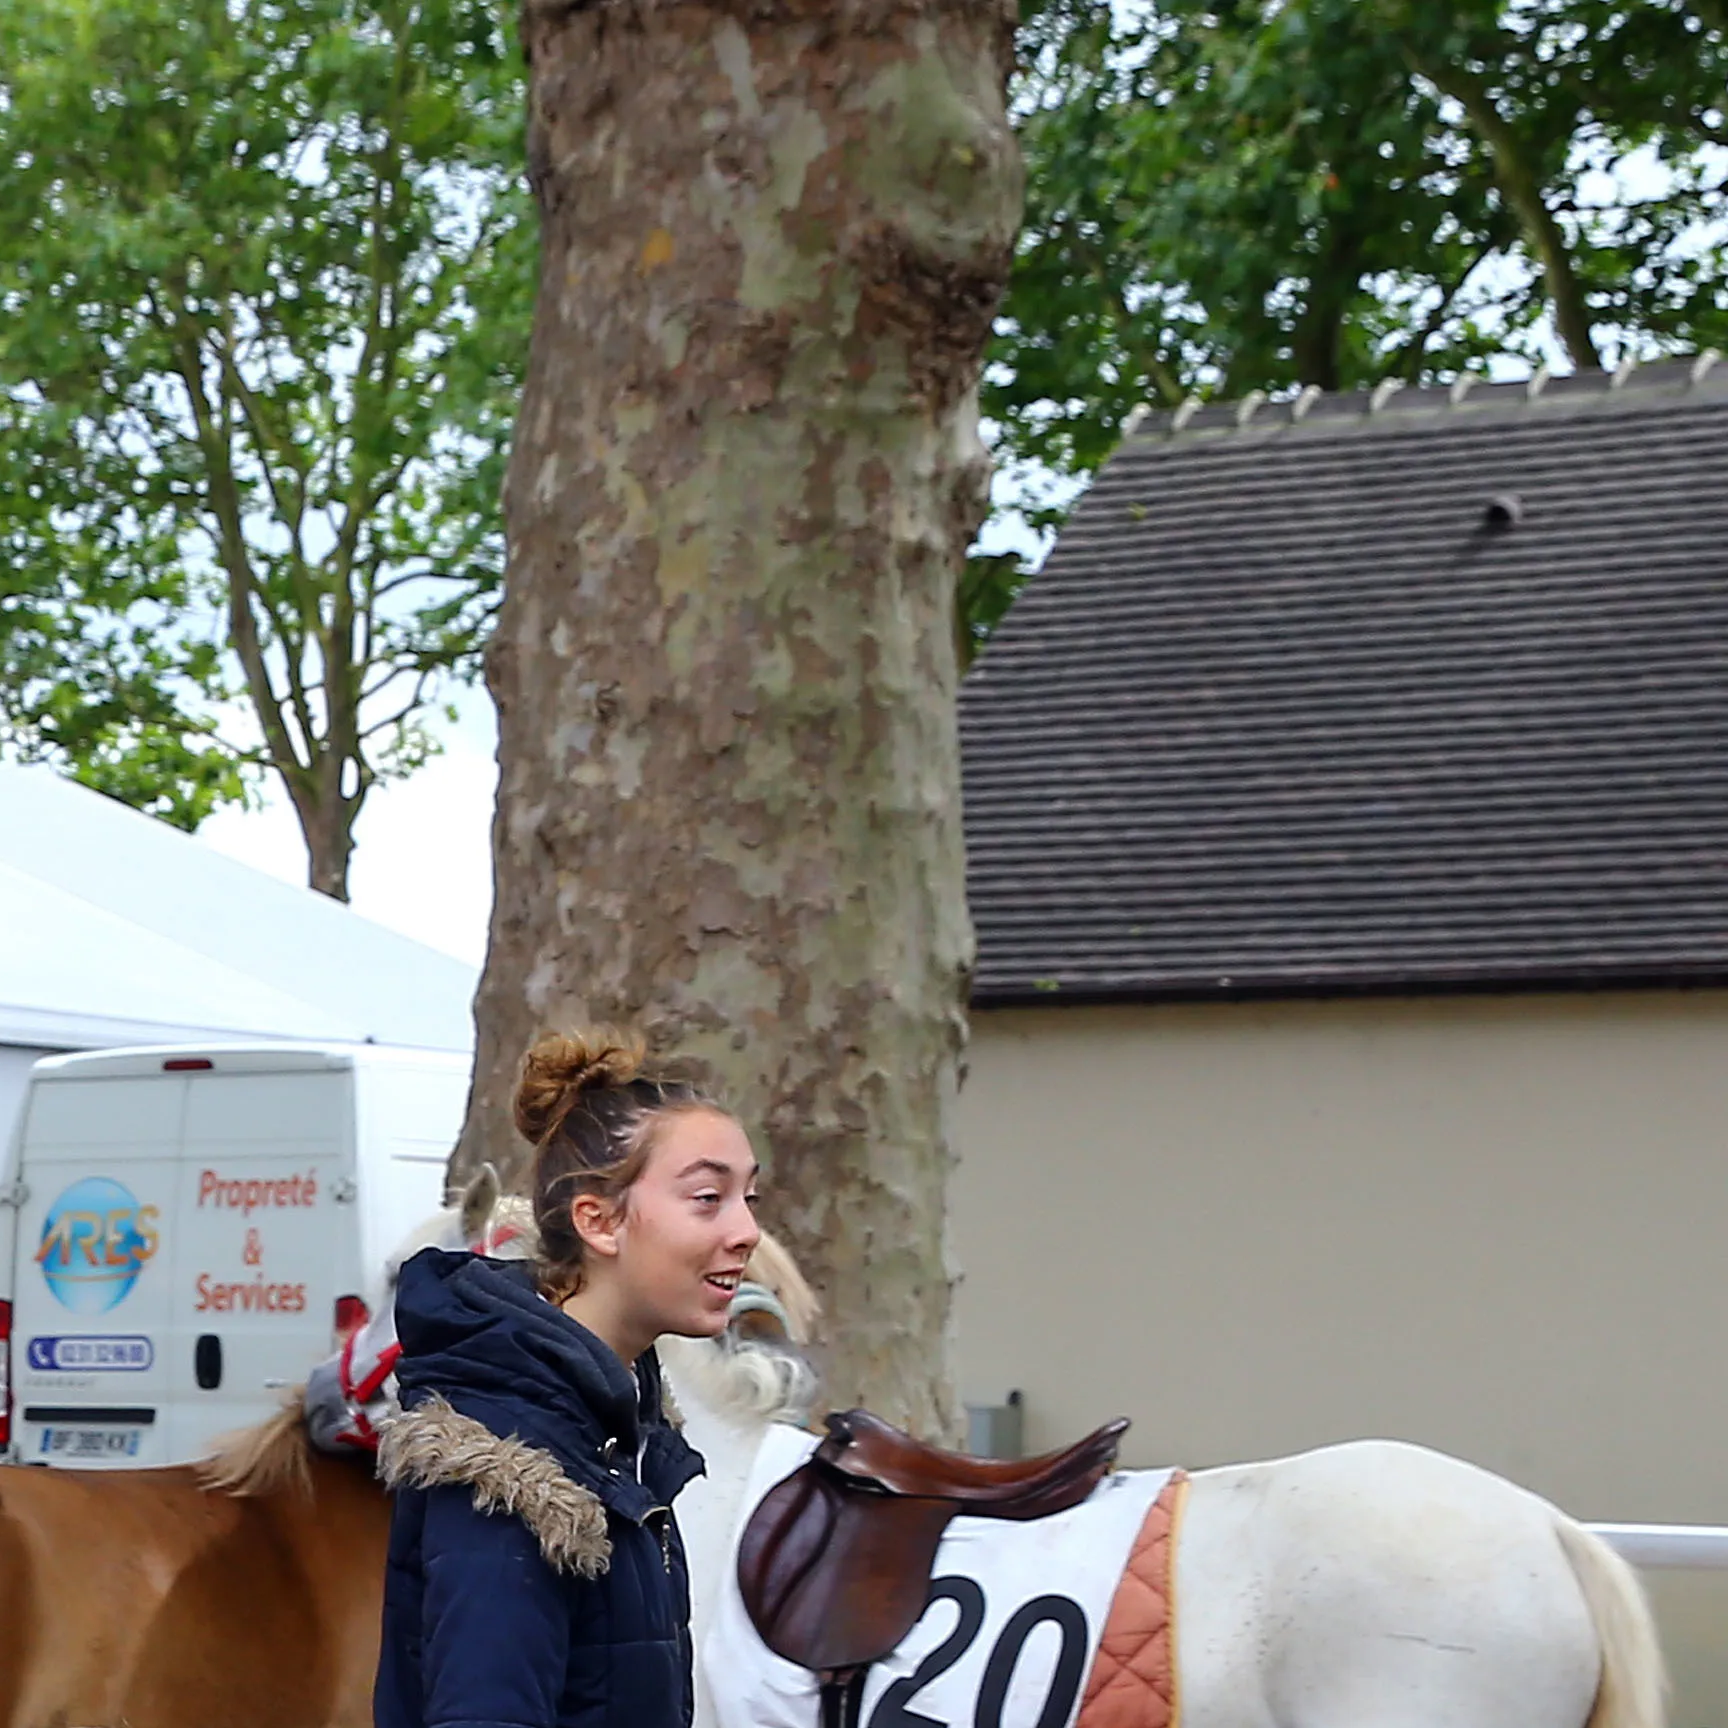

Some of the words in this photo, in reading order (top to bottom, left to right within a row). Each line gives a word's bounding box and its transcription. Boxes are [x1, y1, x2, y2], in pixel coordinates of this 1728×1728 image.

[198, 1166, 318, 1218] Propreté
[33, 1204, 161, 1266] ARES
[242, 1227, 264, 1266] &
[194, 1271, 308, 1314] Services
